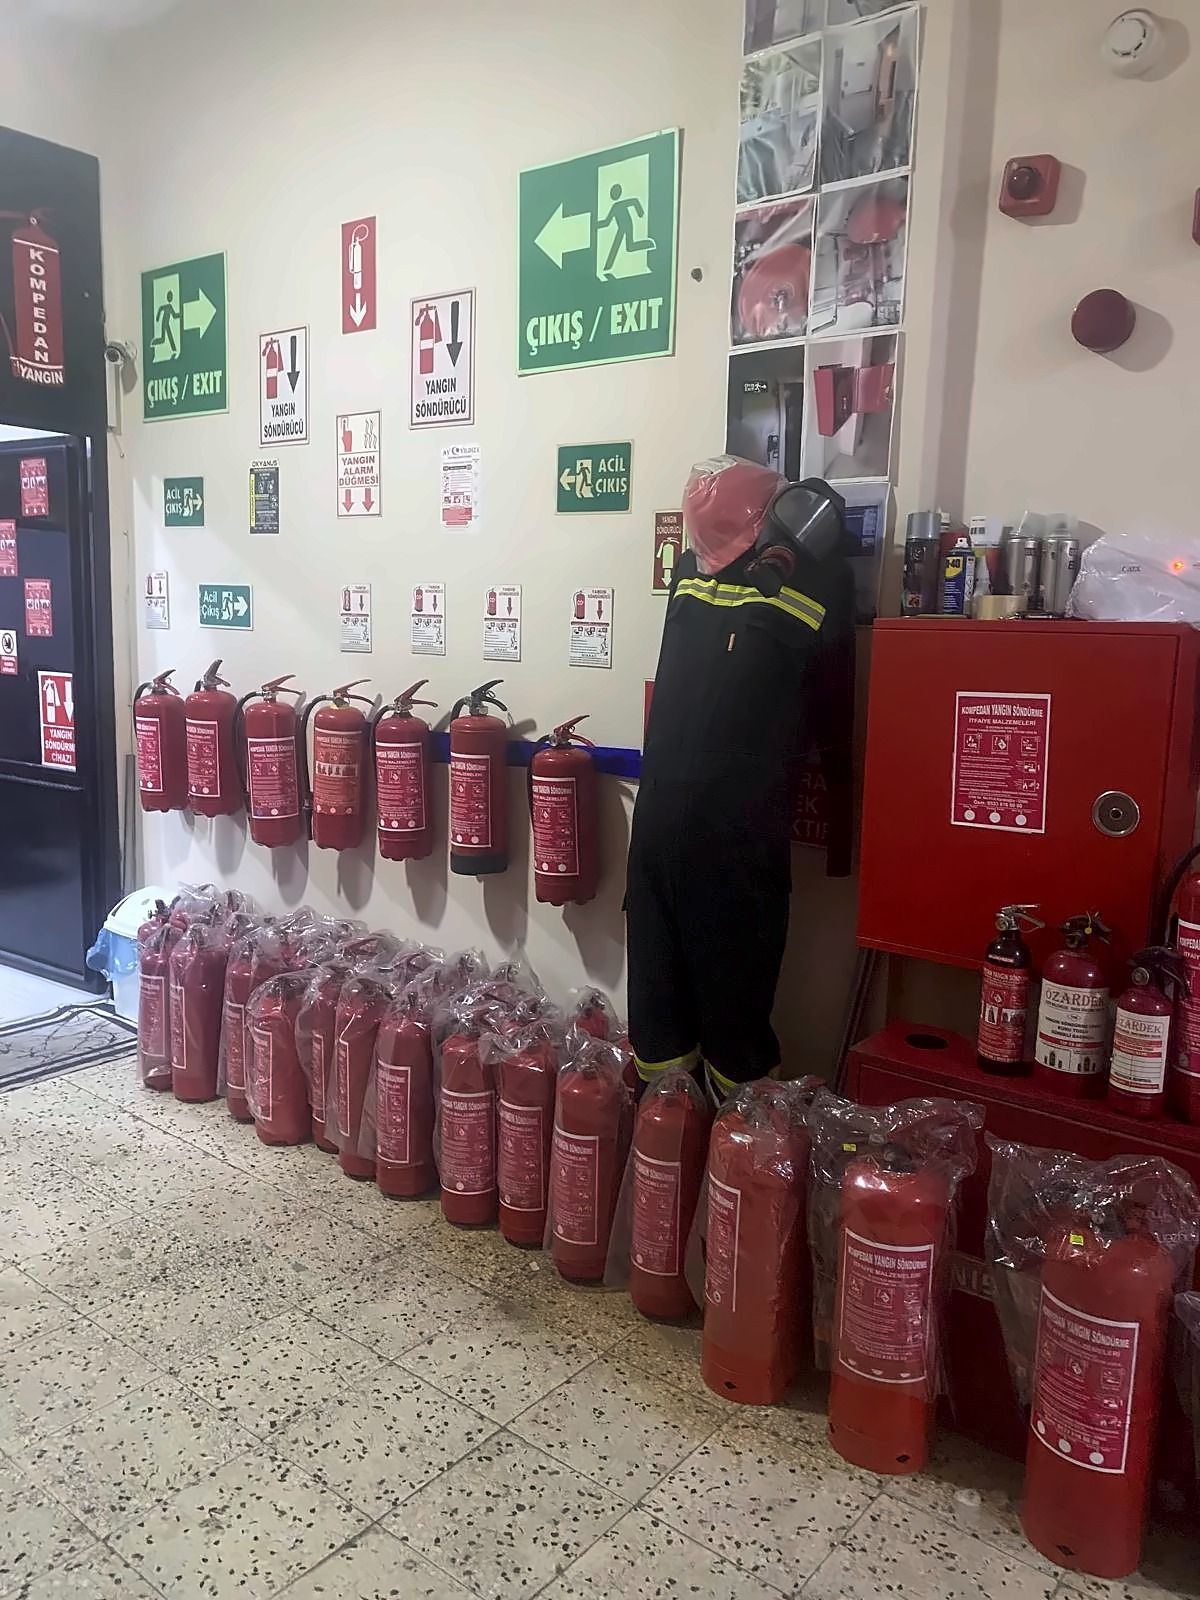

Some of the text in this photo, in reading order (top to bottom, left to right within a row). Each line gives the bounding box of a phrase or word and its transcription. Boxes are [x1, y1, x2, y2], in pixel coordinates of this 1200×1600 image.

[29, 248, 49, 362] KOMPEDAN
[526, 297, 663, 356] ÇIKIŞ / EXIT
[20, 364, 64, 384] YANGIN
[147, 370, 222, 408] ÇIKIŞ / EXIT
[425, 377, 457, 395] YANGIN
[271, 402, 296, 417] YANGIN
[415, 396, 467, 418] SÖNDÜRÜCÜ
[263, 418, 304, 438] SÖNDÜRÜCÜ
[341, 455, 375, 466] YANGIN
[598, 455, 626, 473] ACİL
[343, 465, 374, 476] ALARM
[339, 473, 378, 486] DÜĞMESİ
[595, 477, 627, 497] ÇIKIŞ
[166, 485, 181, 501] ACİL
[165, 502, 183, 517] ÇIKIŞ
[991, 703, 1012, 716] YANGIN
[1012, 704, 1044, 718] SÖNDÜRME
[49, 728, 73, 740] YANGIN
[45, 738, 76, 752] SÖNDÜRM
[1118, 1018, 1161, 1034] ZARDEK
[873, 1254, 897, 1269] YANGIN
[1091, 1329, 1131, 1349] SÖNDÜRME
